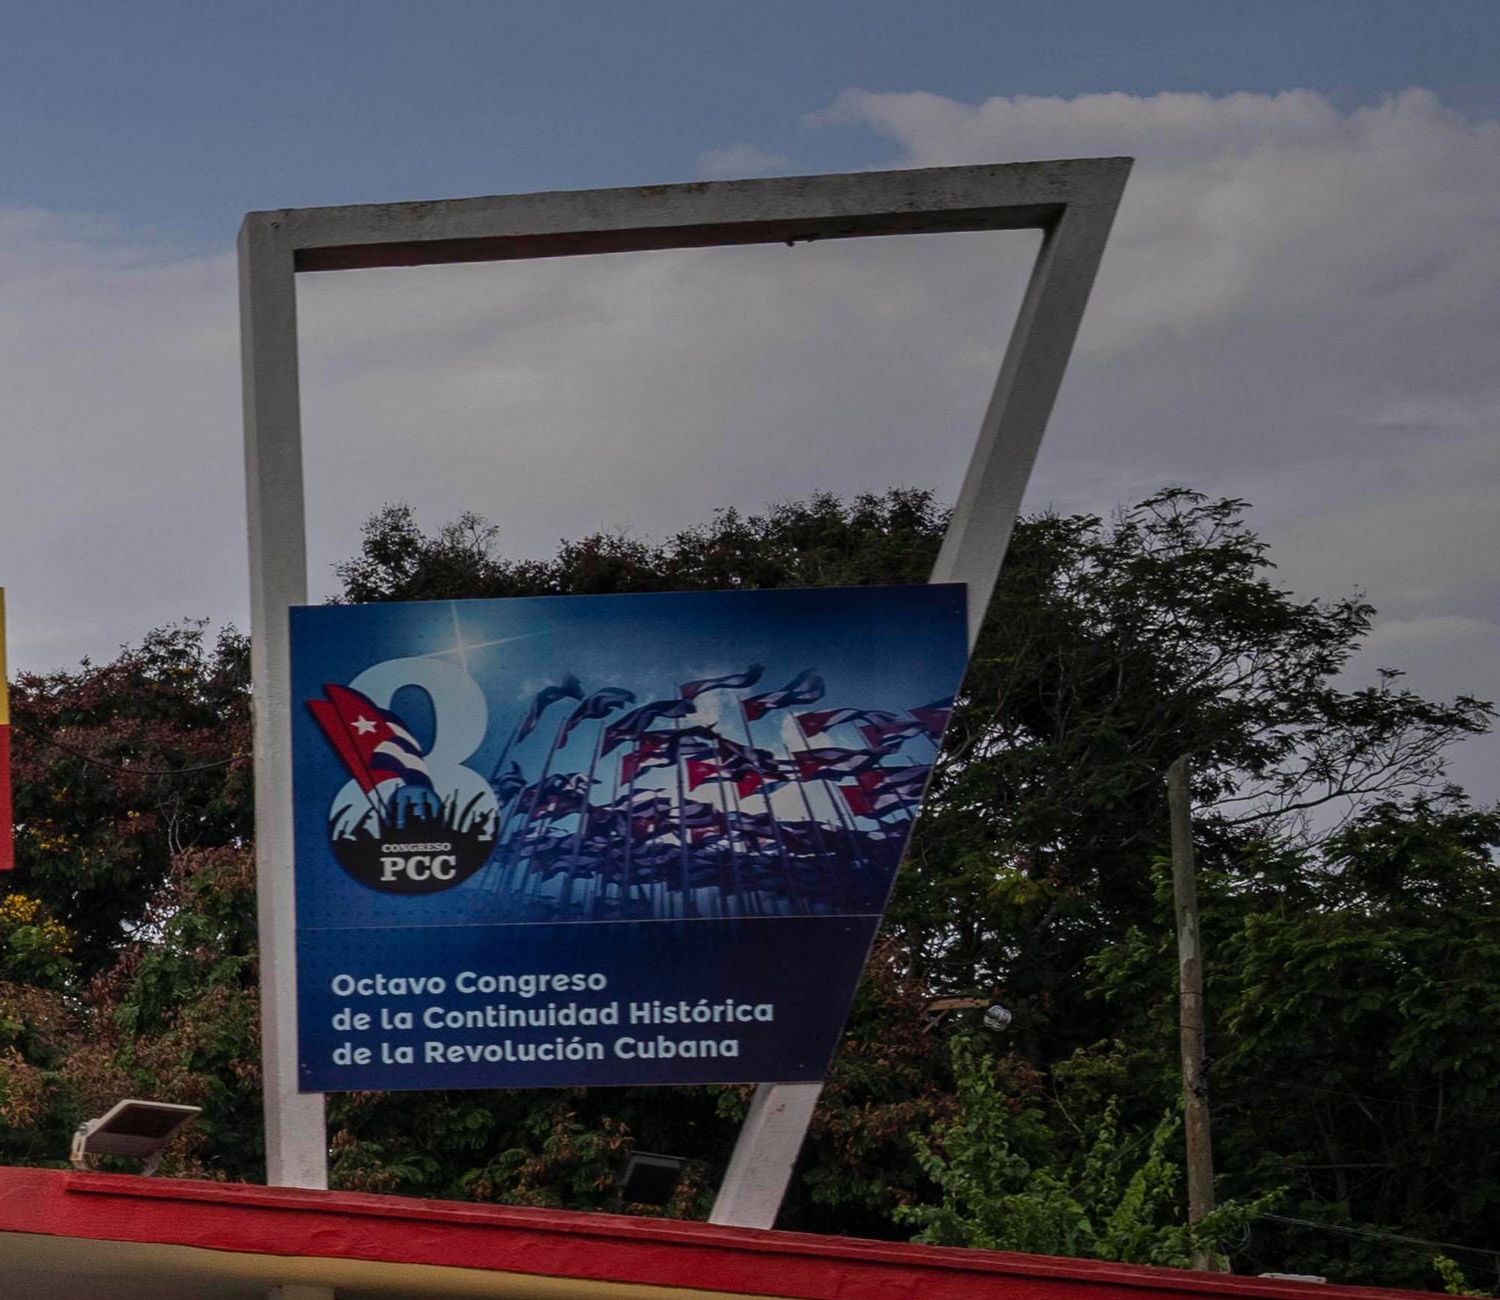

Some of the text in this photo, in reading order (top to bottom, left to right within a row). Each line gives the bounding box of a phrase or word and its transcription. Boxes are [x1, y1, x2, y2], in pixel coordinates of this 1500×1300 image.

[381, 841, 452, 853] CONGRESO
[379, 854, 457, 882] PCC
[331, 970, 607, 999] Octavo Congreso
[331, 998, 774, 1032] de la Continuidad Histórica
[331, 1034, 740, 1066] de la Revolución Cubana
